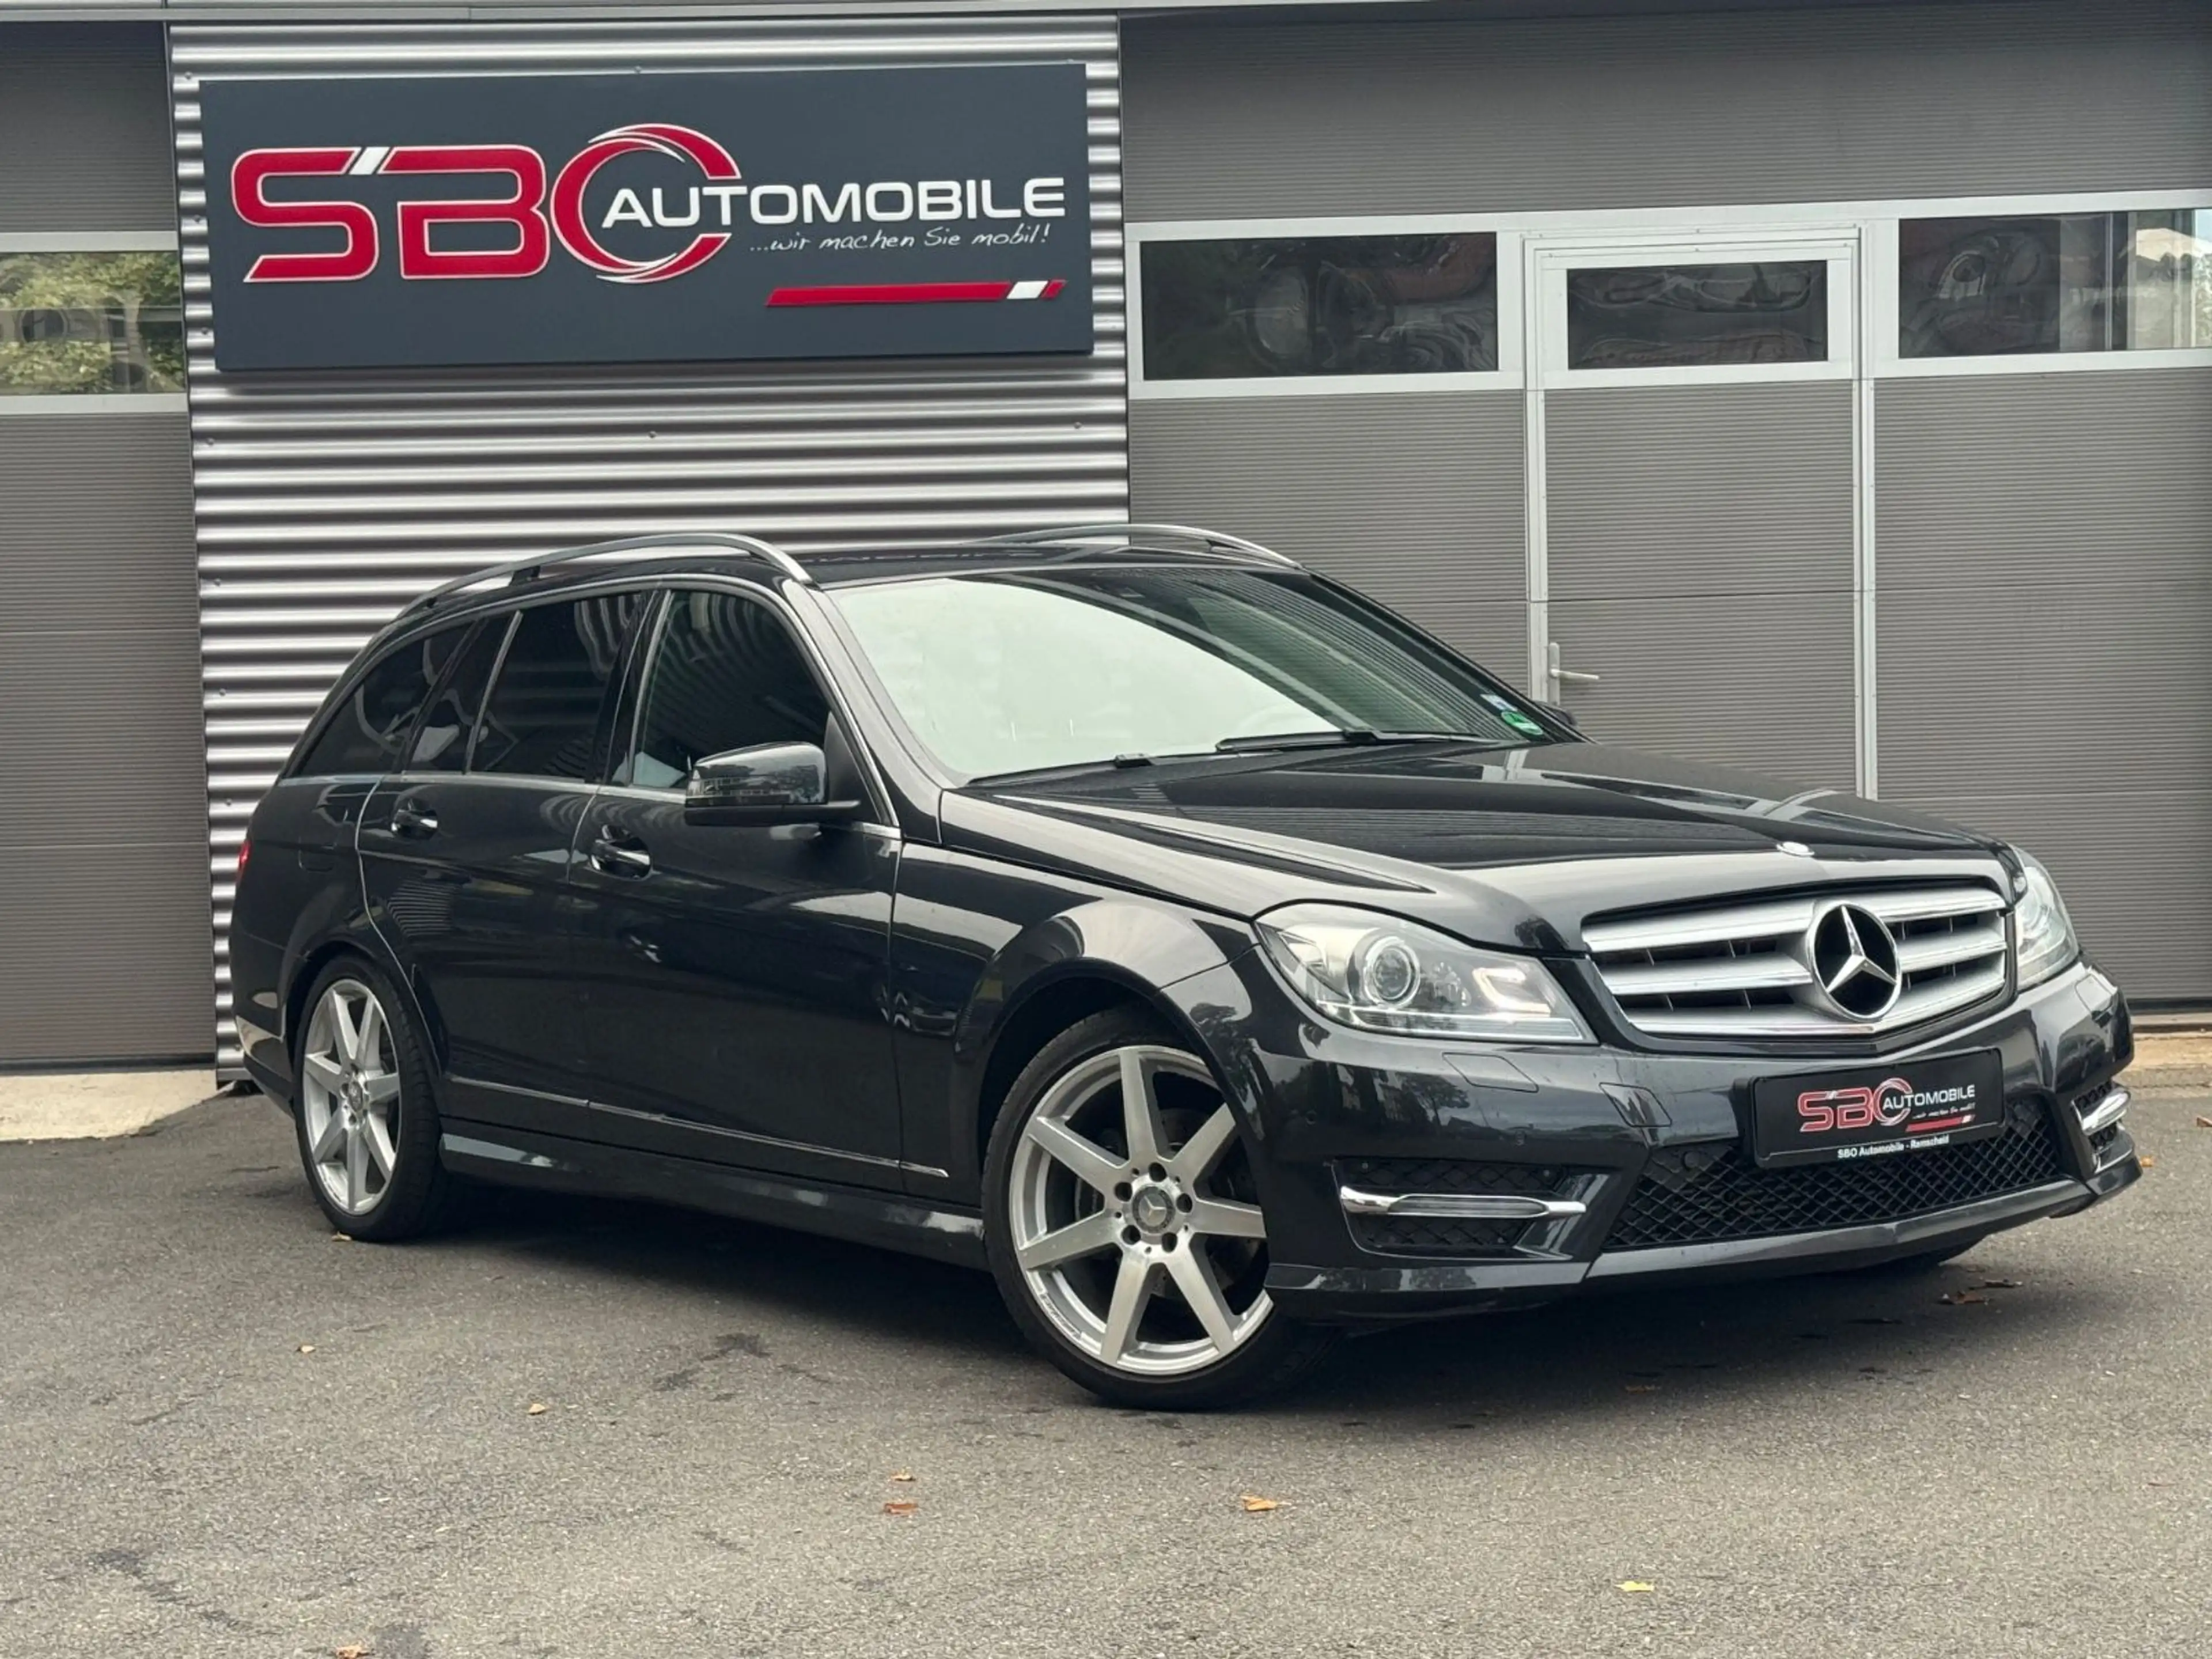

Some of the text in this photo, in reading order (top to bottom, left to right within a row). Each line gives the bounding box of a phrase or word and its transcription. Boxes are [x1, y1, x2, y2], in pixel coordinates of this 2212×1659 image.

[601, 177, 1066, 228] AUTOMOBILE
[819, 229, 914, 249] machen
[924, 226, 961, 247] Sie
[972, 223, 1051, 246] mobil!
[1883, 1084, 1975, 1110] AUTOMOBILE
[1837, 1147, 1858, 1159] SBO
